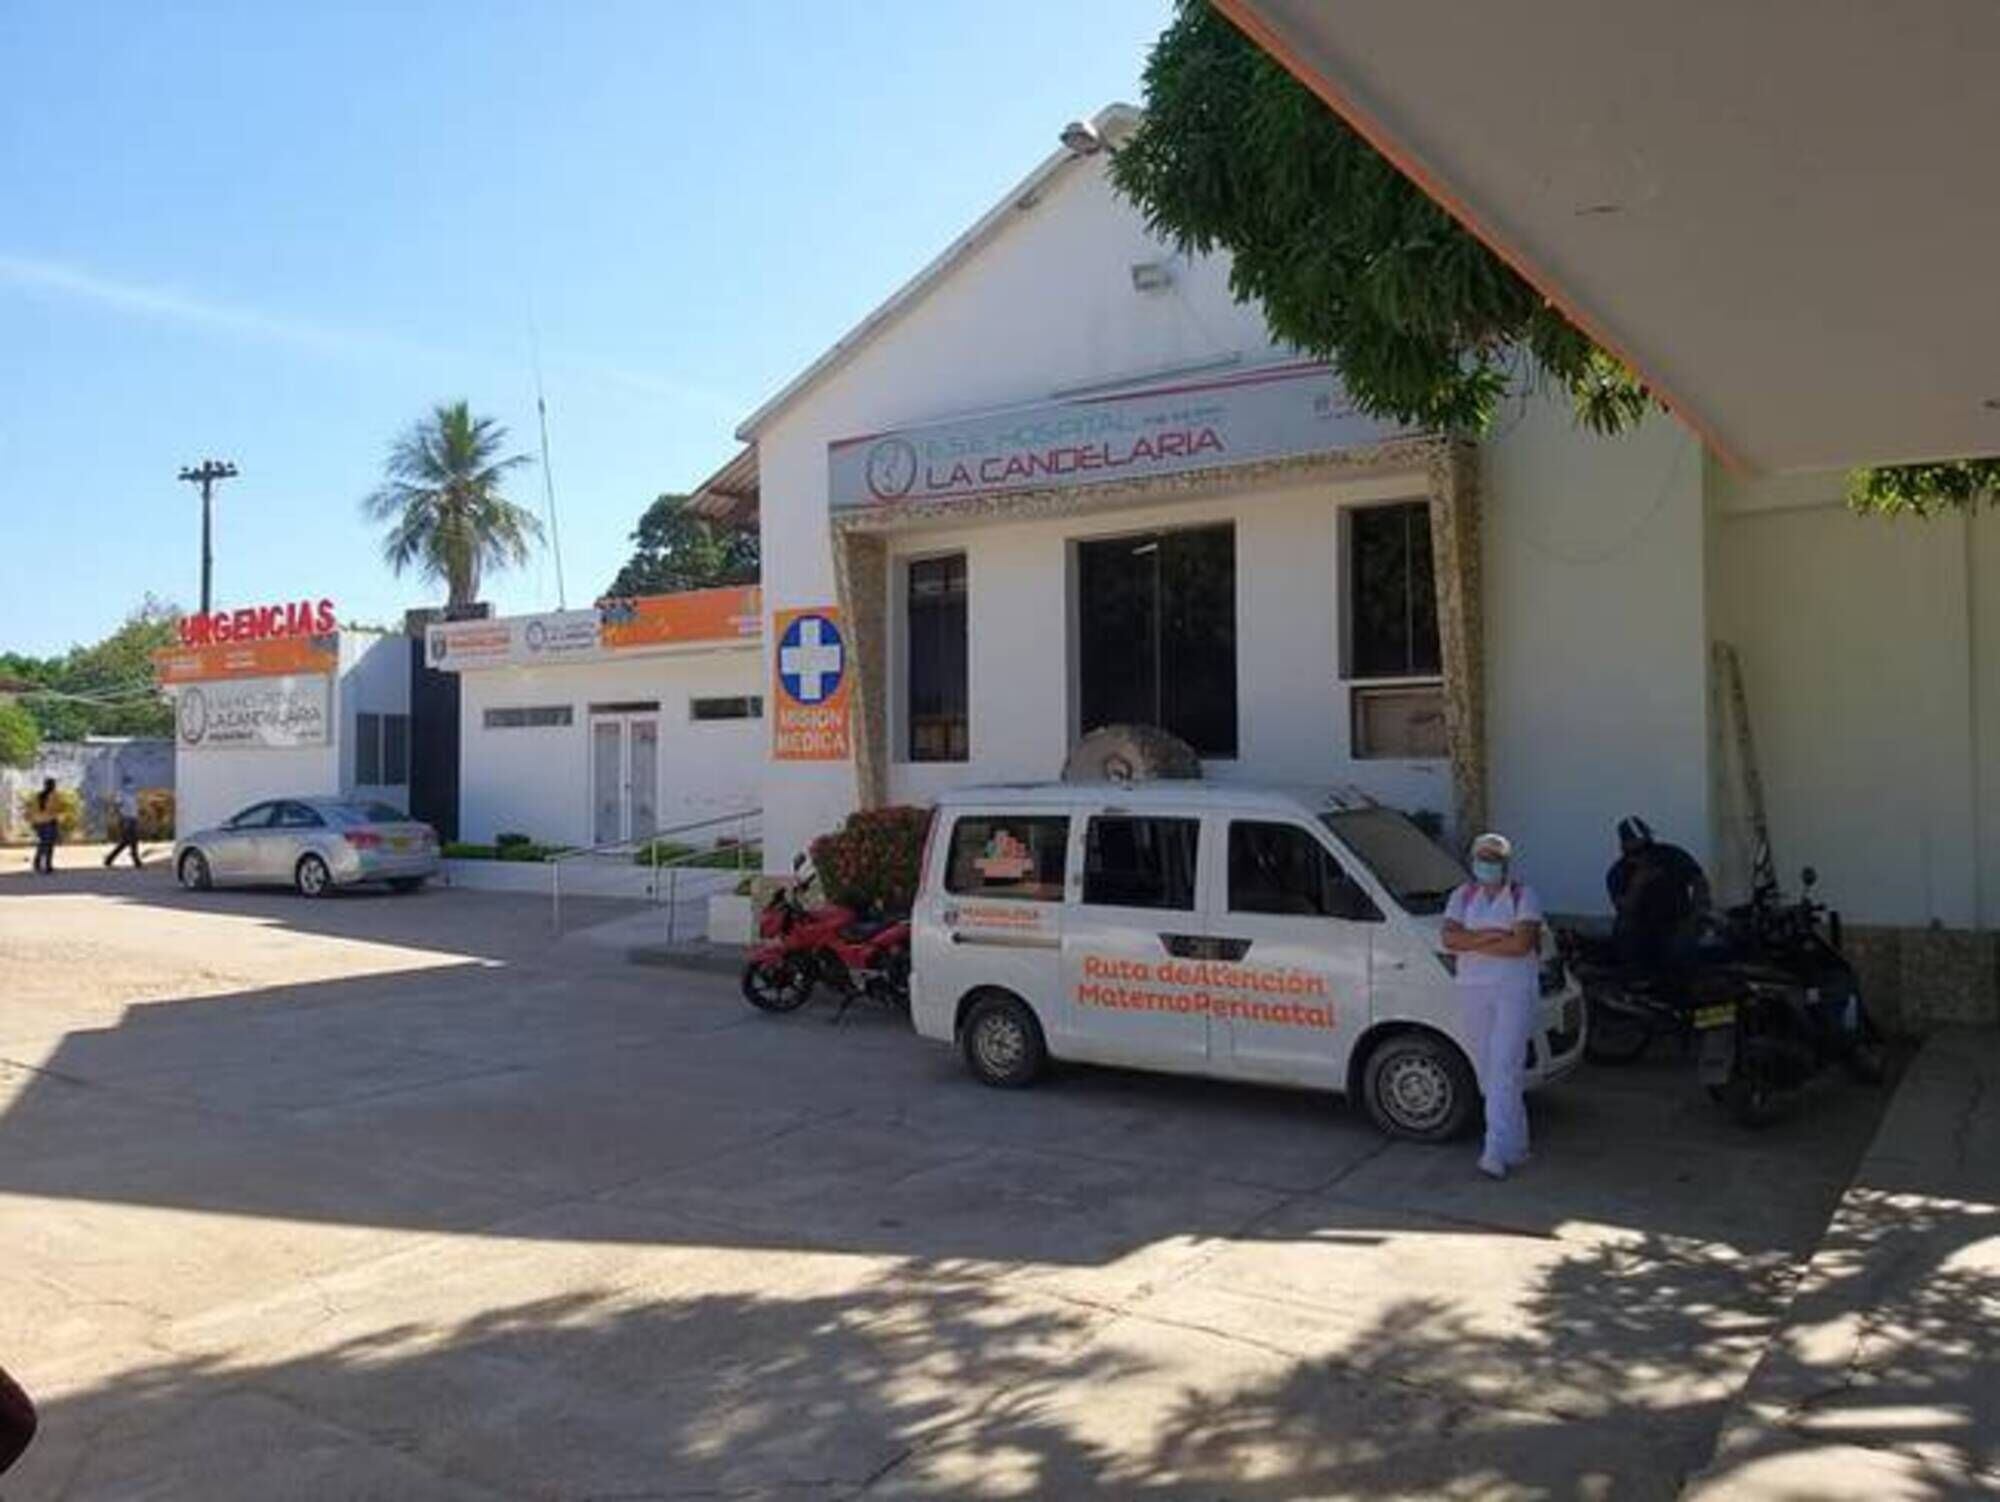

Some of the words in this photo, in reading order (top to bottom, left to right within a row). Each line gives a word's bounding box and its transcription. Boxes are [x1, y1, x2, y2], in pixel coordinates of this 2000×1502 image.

[926, 465, 973, 489] LA
[979, 427, 1226, 484] CANDELARIA
[180, 598, 336, 646] URGENCIAS
[1082, 955, 1149, 982] Ruta
